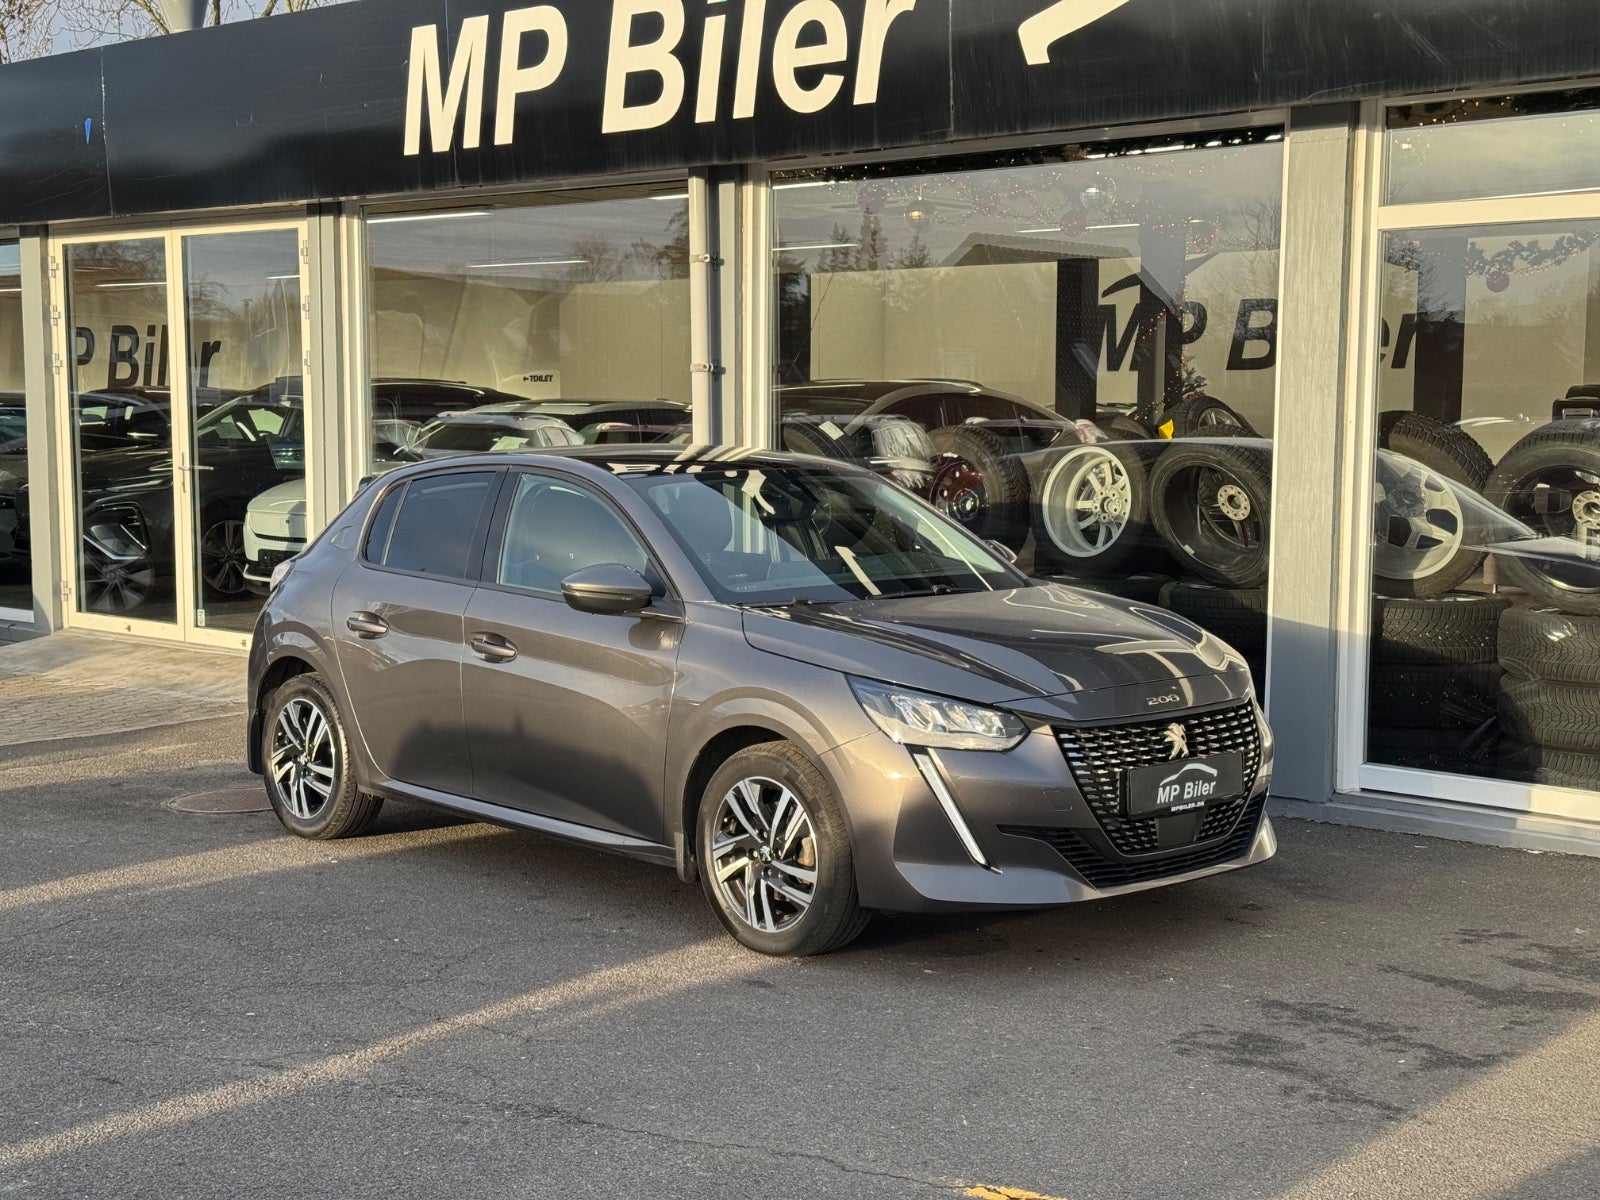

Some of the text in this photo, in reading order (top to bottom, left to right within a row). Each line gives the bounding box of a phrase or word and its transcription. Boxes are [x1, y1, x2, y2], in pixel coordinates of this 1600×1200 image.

[404, 0, 916, 156] MP Biler
[107, 324, 222, 389] Bilr
[1157, 780, 1216, 804] MP Biler
